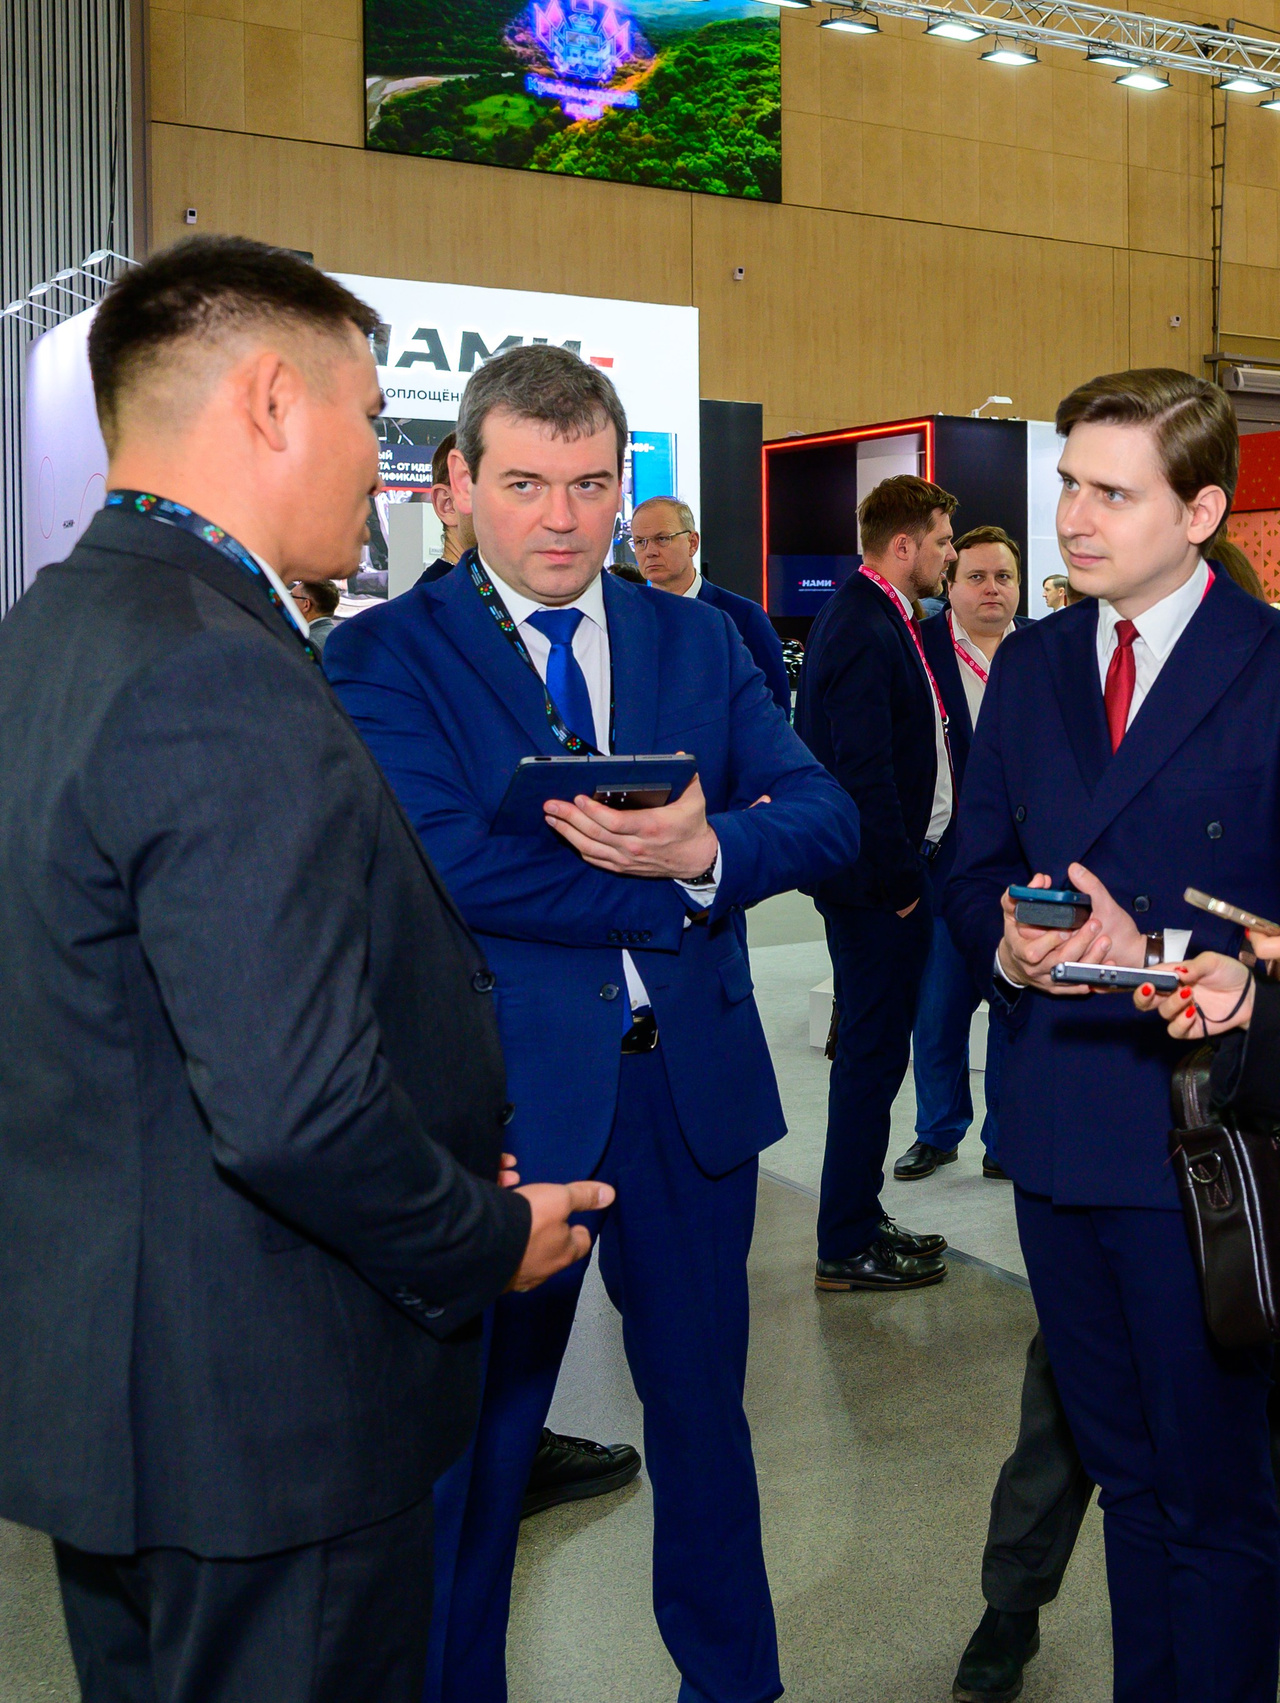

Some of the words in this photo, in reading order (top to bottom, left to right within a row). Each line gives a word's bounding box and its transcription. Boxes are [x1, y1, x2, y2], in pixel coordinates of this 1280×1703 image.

[380, 387, 463, 402] ОПЛОЩЁН
[396, 462, 410, 471] ОТ
[411, 463, 432, 473] ИДЕ
[802, 579, 832, 587] НАМИ
